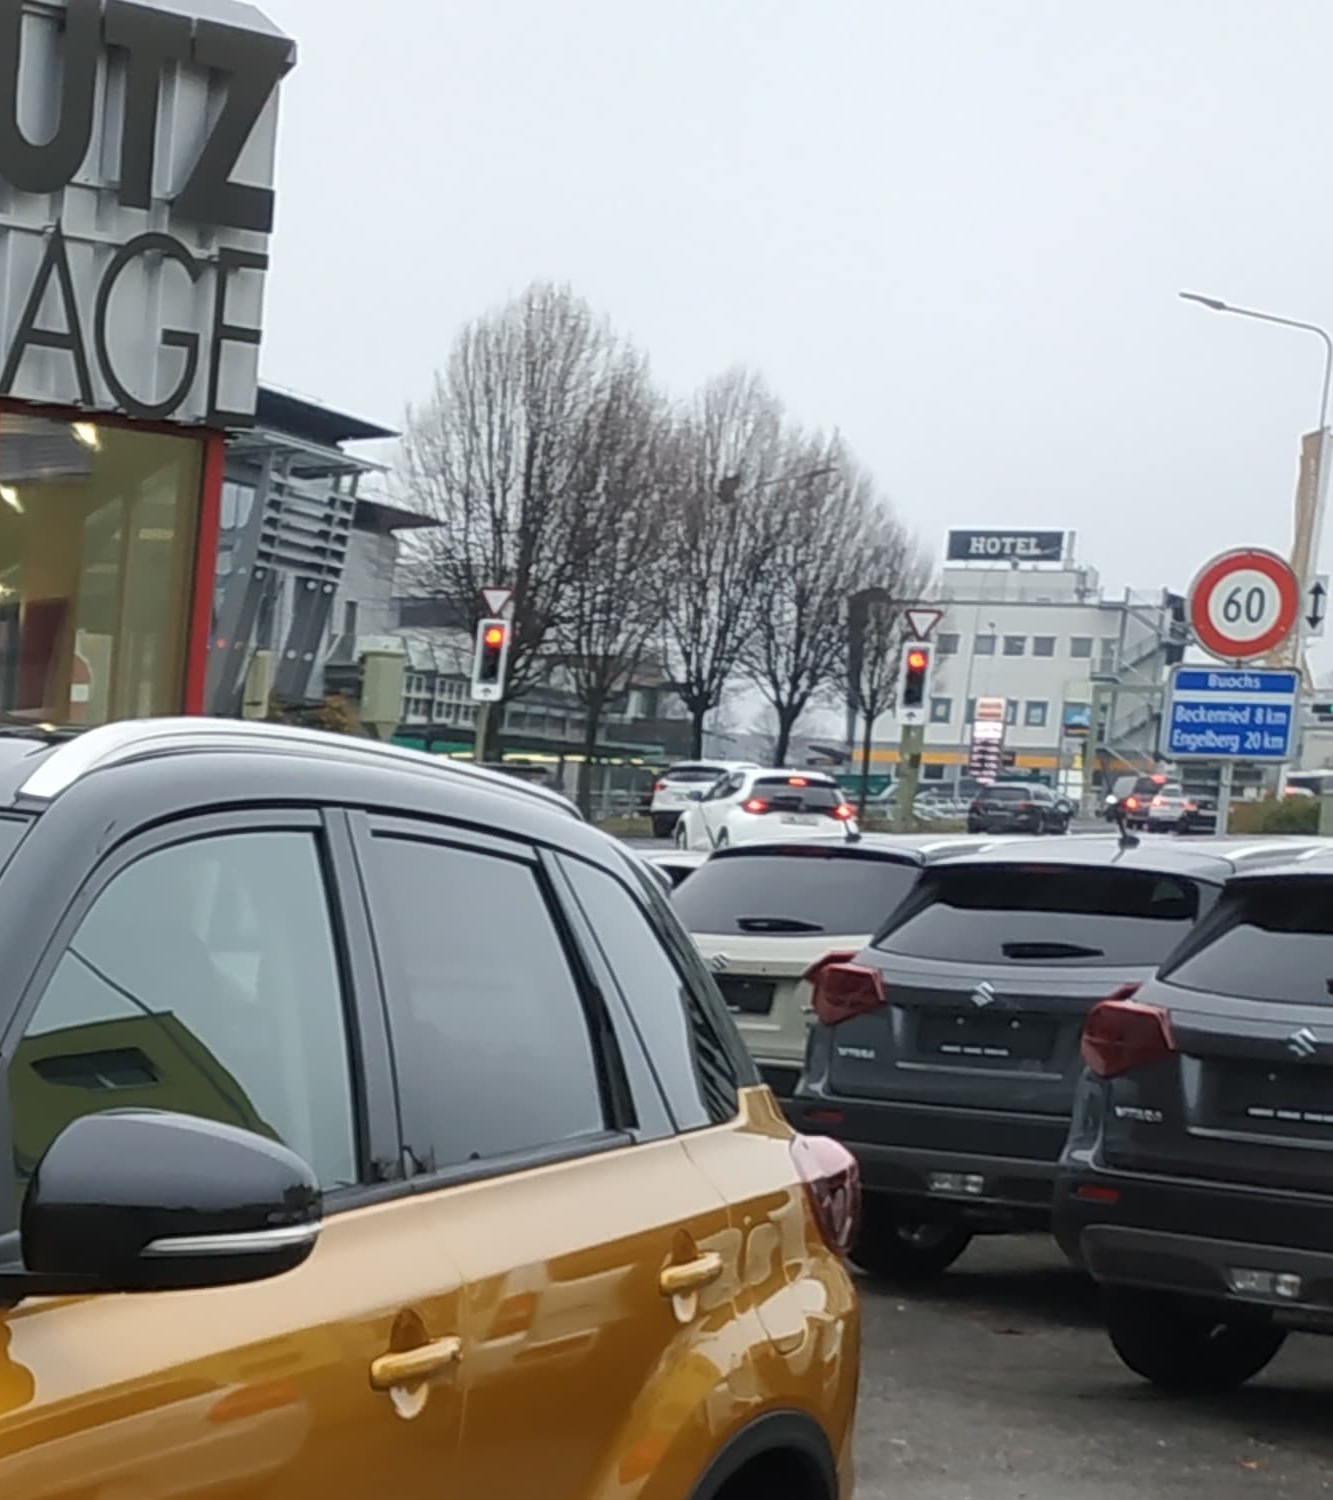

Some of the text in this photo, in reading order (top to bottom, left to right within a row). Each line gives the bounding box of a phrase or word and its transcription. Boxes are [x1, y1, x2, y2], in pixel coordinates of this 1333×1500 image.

[968, 537, 1042, 556] HOTEL
[1223, 586, 1265, 623] 60
[1207, 673, 1261, 688] Buochs
[1175, 705, 1287, 724] Beckenried 8 km
[1172, 729, 1284, 752] Engelberg 20 km
